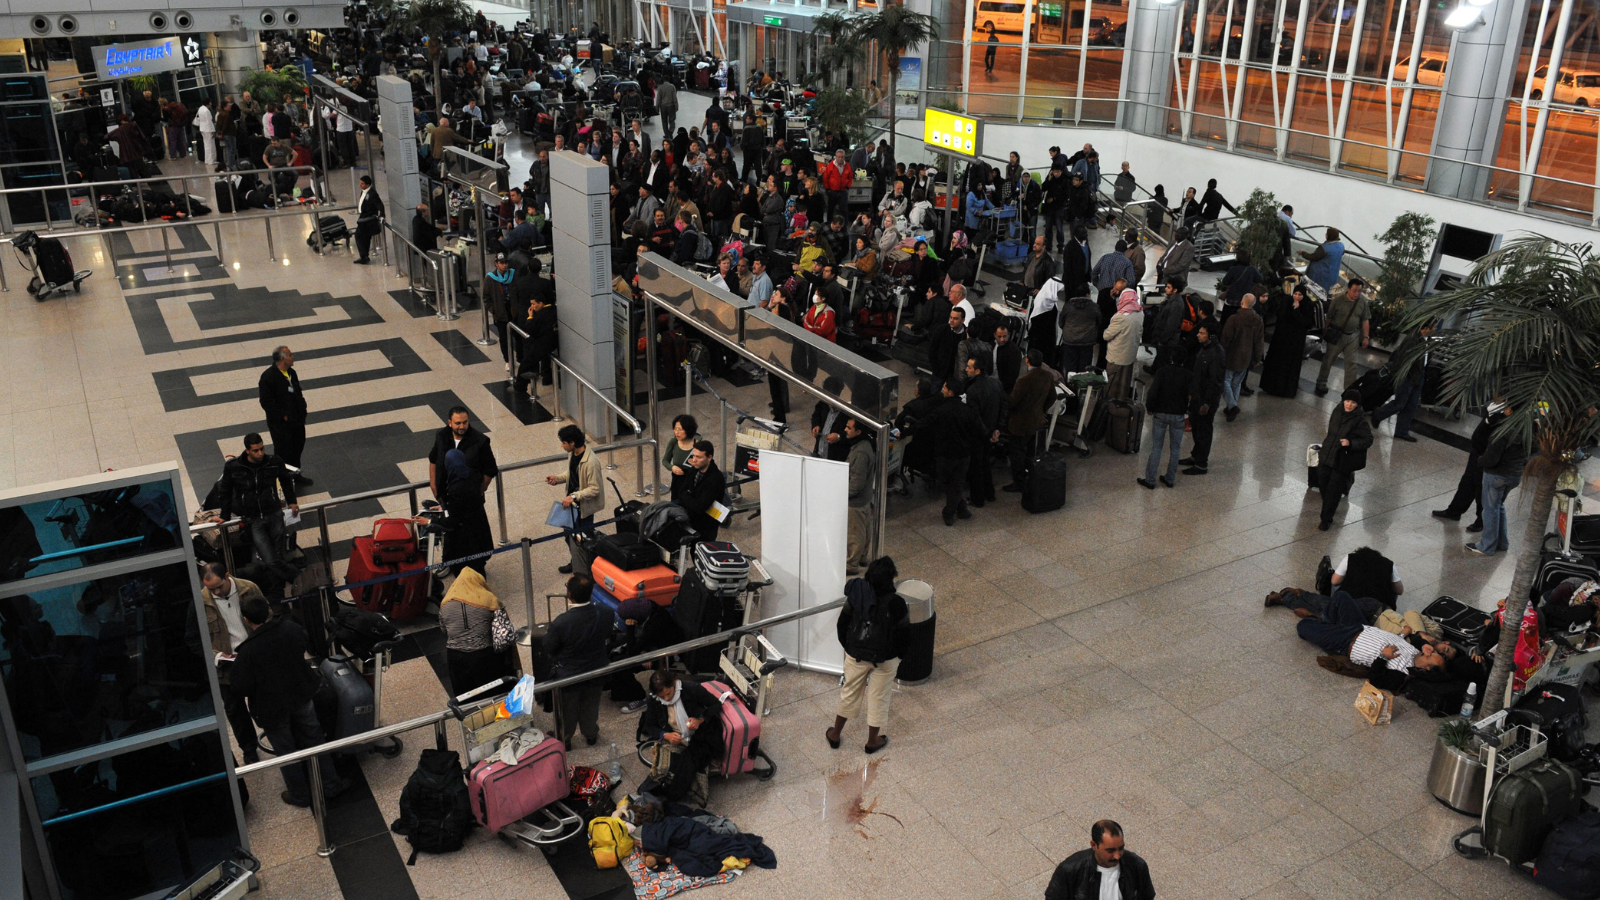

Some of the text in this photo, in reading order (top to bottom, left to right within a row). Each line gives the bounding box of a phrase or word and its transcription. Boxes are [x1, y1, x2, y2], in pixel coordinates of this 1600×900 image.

[106, 46, 164, 66] EGYPTAIR
[424, 550, 494, 572] CAIRO AIRPORT COMPANY
